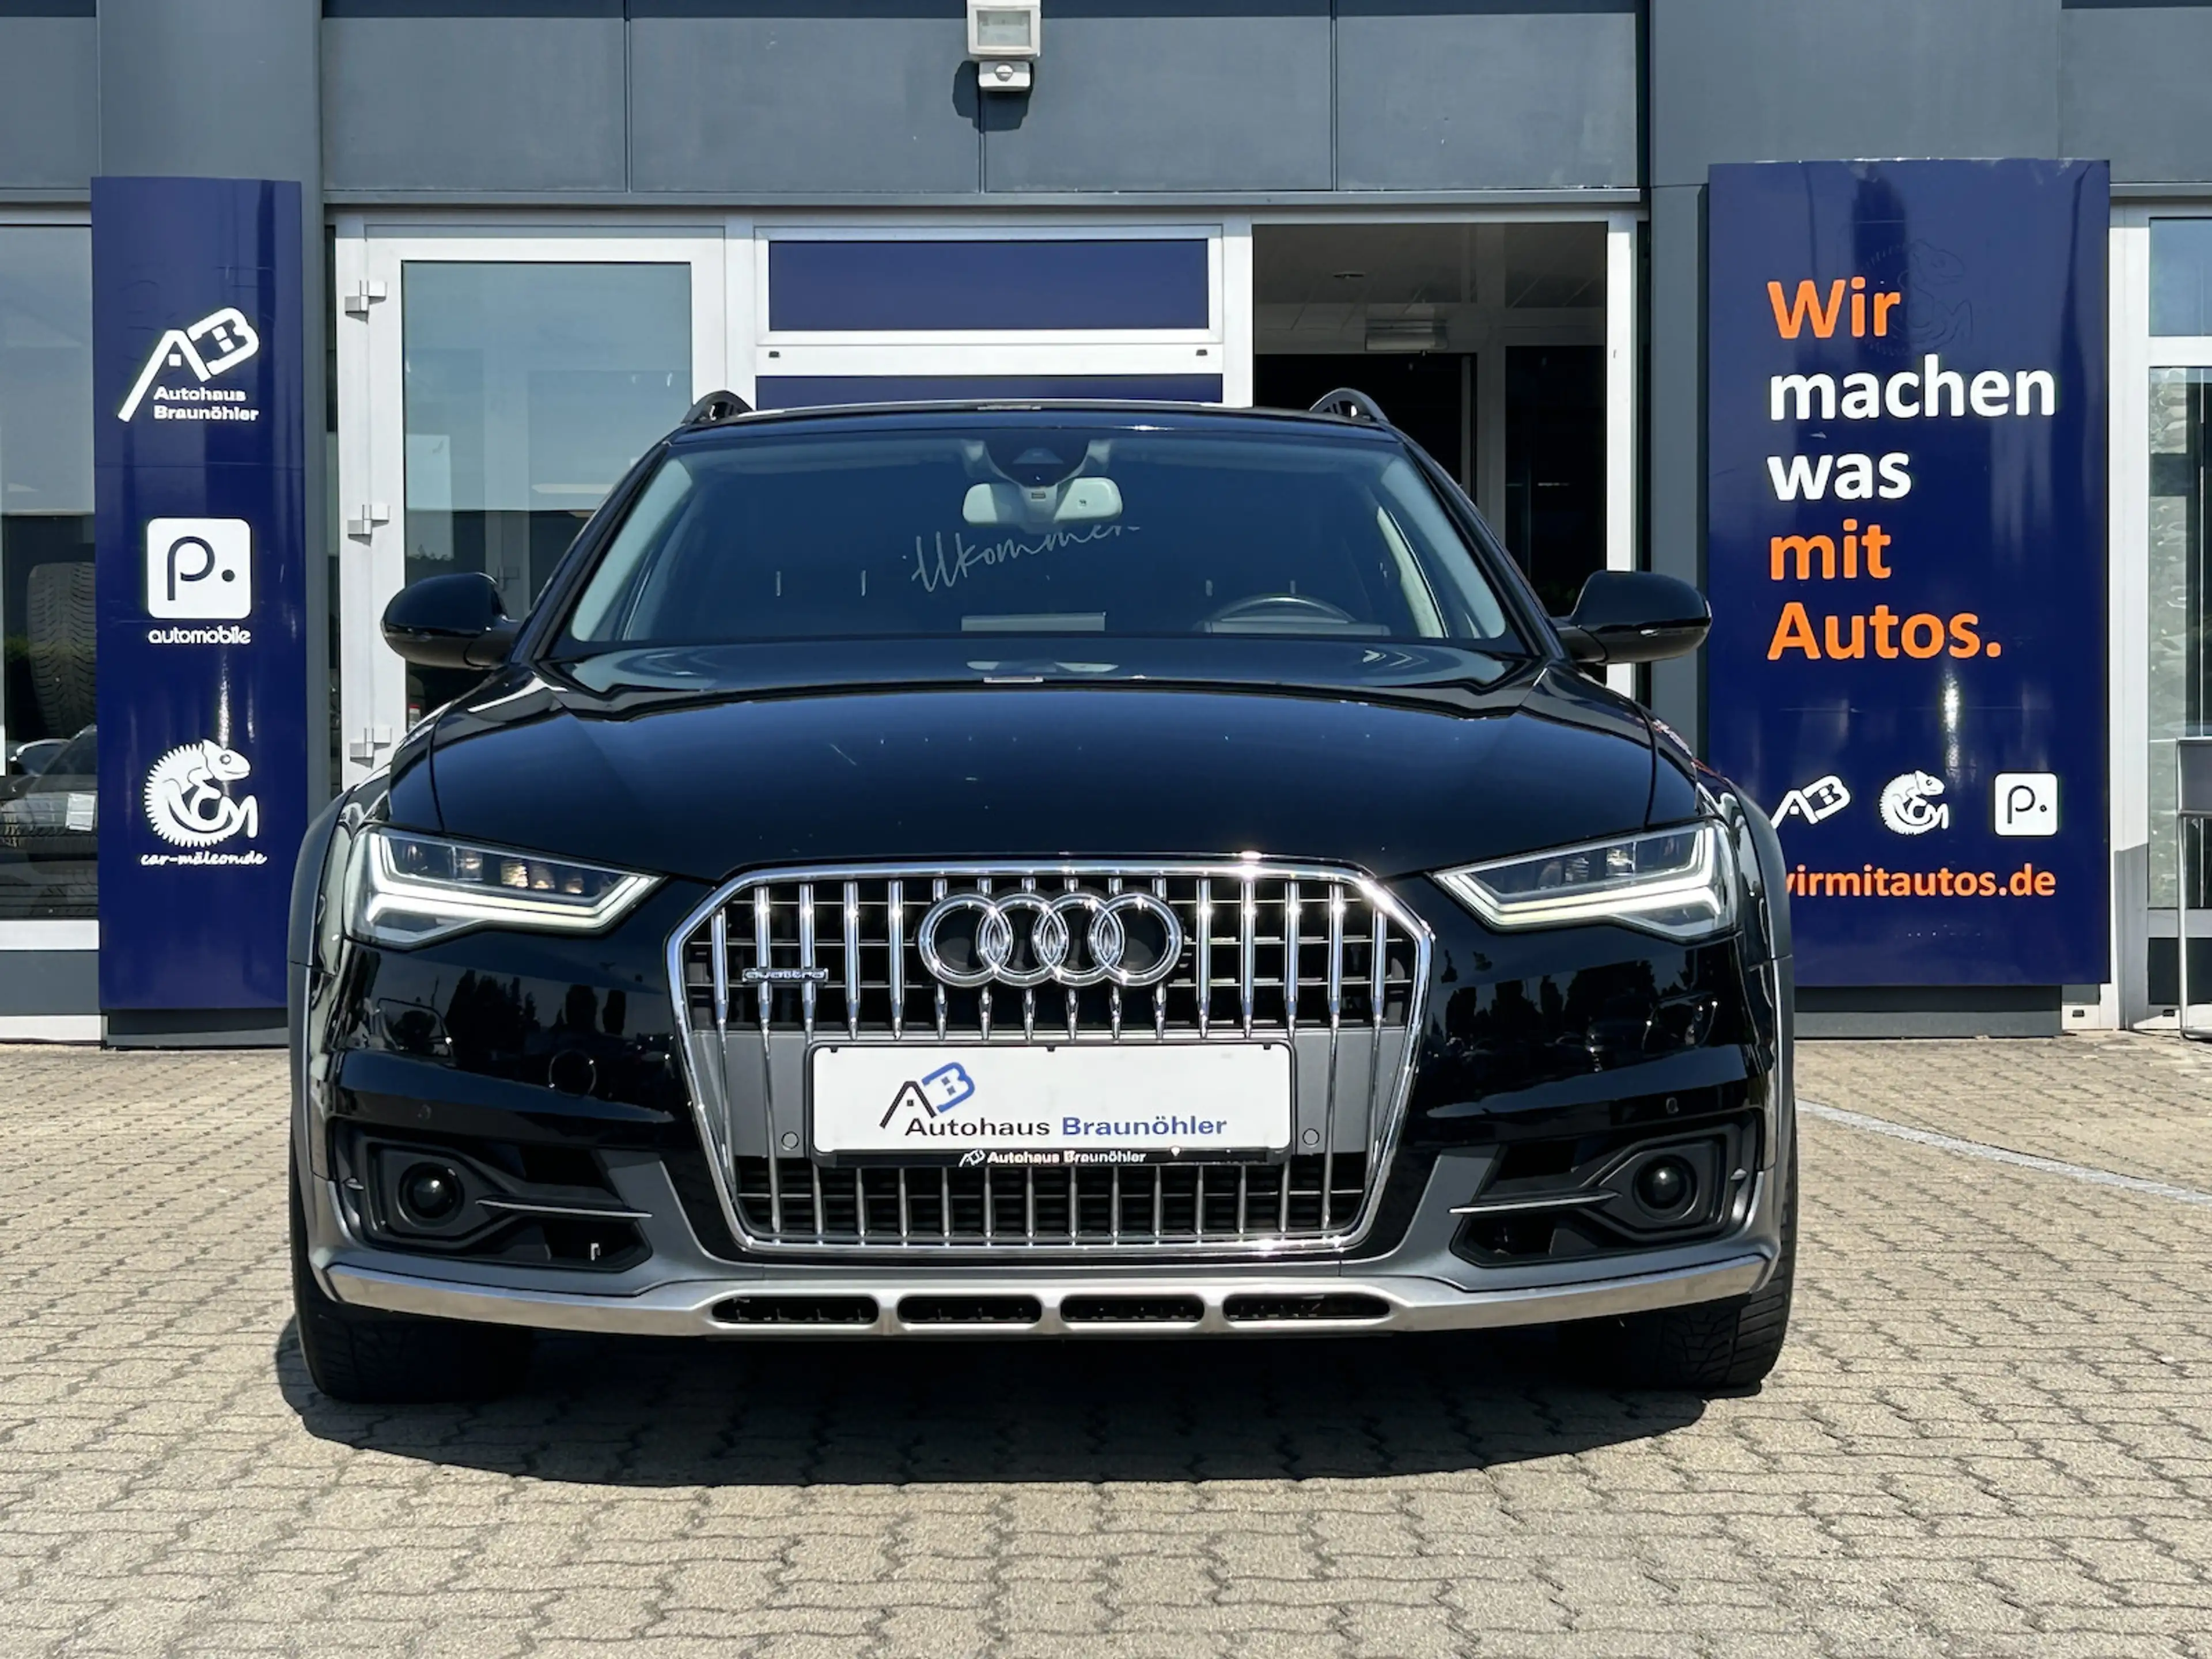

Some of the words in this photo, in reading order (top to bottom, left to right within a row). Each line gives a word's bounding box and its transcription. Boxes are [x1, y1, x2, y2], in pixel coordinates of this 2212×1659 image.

[1767, 276, 1901, 339] Wir
[154, 386, 247, 402] Autohaus
[1770, 354, 2055, 421] machen
[154, 405, 259, 421] Braunöhler
[1767, 452, 1912, 501] was
[1770, 518, 1892, 581] mit
[147, 625, 251, 644] automobile
[1767, 602, 2002, 660] Autos.
[904, 1117, 1050, 1136] Autohaus
[1063, 1115, 1227, 1136] Braunöhler
[987, 1151, 1060, 1164] Autohaus
[1063, 1150, 1146, 1164] Braunöhler
